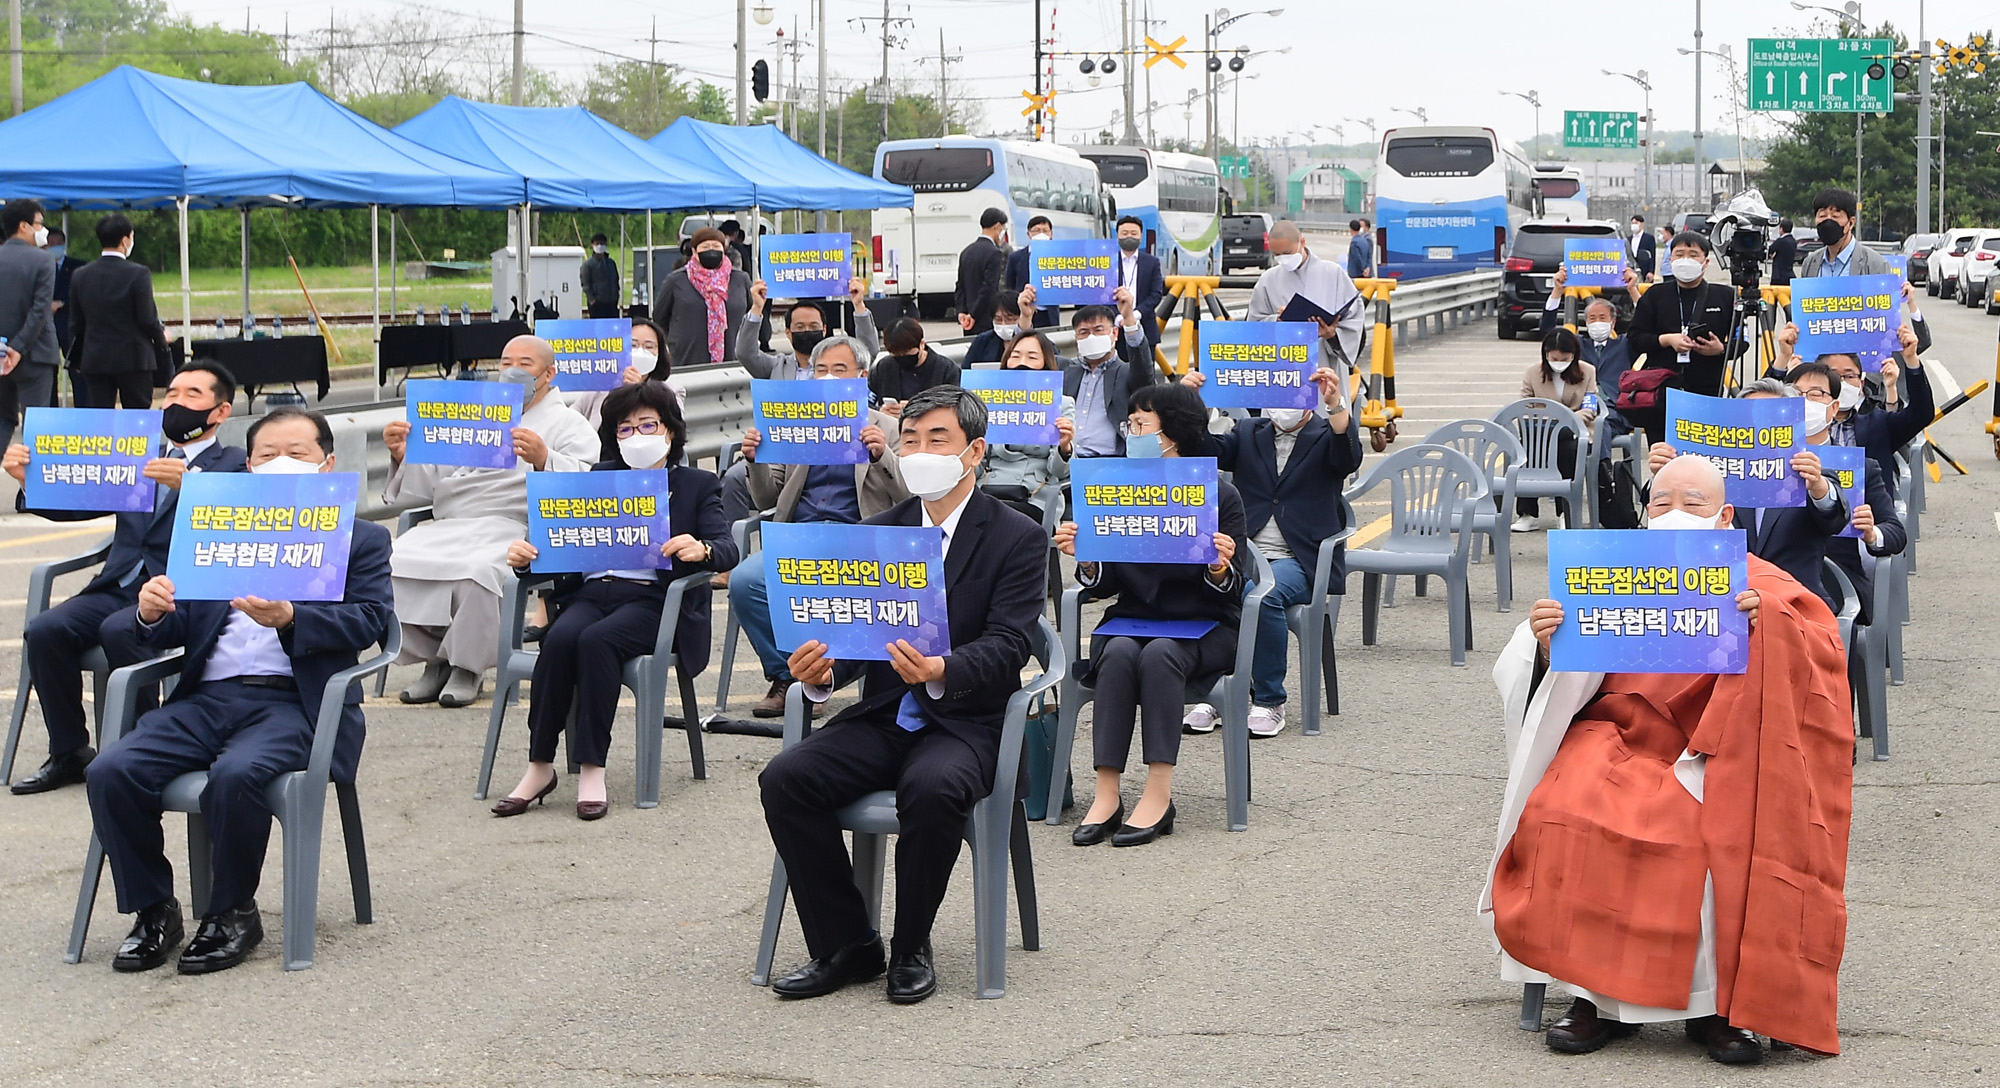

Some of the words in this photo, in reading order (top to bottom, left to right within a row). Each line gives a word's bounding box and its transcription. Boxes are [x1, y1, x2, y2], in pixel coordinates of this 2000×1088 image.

[1758, 100, 1780, 109] 1차로
[1791, 100, 1815, 109] 2차로
[1821, 94, 1842, 102] 300m
[1826, 101, 1849, 110] 3차로
[1860, 101, 1883, 110] 4차로
[1405, 217, 1476, 228] 판문점견학지원센터
[769, 251, 821, 264] 판문점선언
[824, 249, 844, 262] 이행
[1038, 257, 1087, 270] 판문점선언
[1089, 256, 1110, 269] 이행
[1568, 251, 1604, 261] 판문점선언
[1606, 251, 1621, 261] 이행
[774, 268, 816, 282] 남북협력
[817, 267, 839, 281] 재개
[1571, 264, 1602, 275] 남북협력
[1602, 264, 1618, 274] 재개
[1041, 274, 1082, 289] 남북협력
[1083, 274, 1105, 289] 재개
[1801, 295, 1863, 313] 판문점선언
[1866, 293, 1891, 310] 이행
[1808, 318, 1858, 335] 남북협력
[1860, 316, 1886, 333] 재개
[599, 337, 623, 353] 이행
[1209, 344, 1277, 362] 판문점선언
[1279, 345, 1308, 363] 이행
[594, 358, 618, 374] 재개
[1216, 368, 1270, 387] 남북협력
[1272, 369, 1301, 388] 재개
[1030, 390, 1053, 405] 이행
[417, 402, 482, 422] 판문점선언
[484, 404, 513, 423] 이행
[761, 401, 826, 419] 판문점선언
[828, 400, 857, 418] 이행
[1021, 410, 1047, 426] 재개
[423, 425, 474, 446] 남북협력
[474, 427, 502, 448] 재개
[768, 425, 819, 444] 남북협력
[822, 425, 852, 443] 재개
[1675, 418, 1755, 449] 판문점선언
[1758, 426, 1794, 449] 이행
[35, 434, 113, 457] 판문점선언
[115, 435, 148, 457] 이행
[41, 463, 102, 485] 남북협력
[104, 464, 137, 486] 재개
[1748, 457, 1785, 480] 재개
[1085, 485, 1167, 507] 판문점선언
[1170, 485, 1206, 507] 이행
[539, 497, 619, 519] 판문점선언
[622, 496, 656, 518] 이행
[191, 505, 294, 532] 판문점선언
[297, 505, 340, 532] 이행
[1093, 515, 1159, 537] 남북협력
[1162, 515, 1197, 537] 재개
[548, 526, 613, 548] 남북협력
[615, 525, 649, 547] 재개
[194, 541, 279, 568] 남북협력
[280, 542, 324, 568] 재개
[777, 557, 881, 588] 판문점선언
[884, 562, 928, 590] 이행
[1565, 566, 1679, 596] 판문점선언
[1682, 567, 1730, 596] 이행
[790, 597, 874, 625] 남북협력
[876, 599, 919, 628] 재개
[1578, 608, 1667, 636] 남북협력
[1672, 608, 1719, 637] 재개
